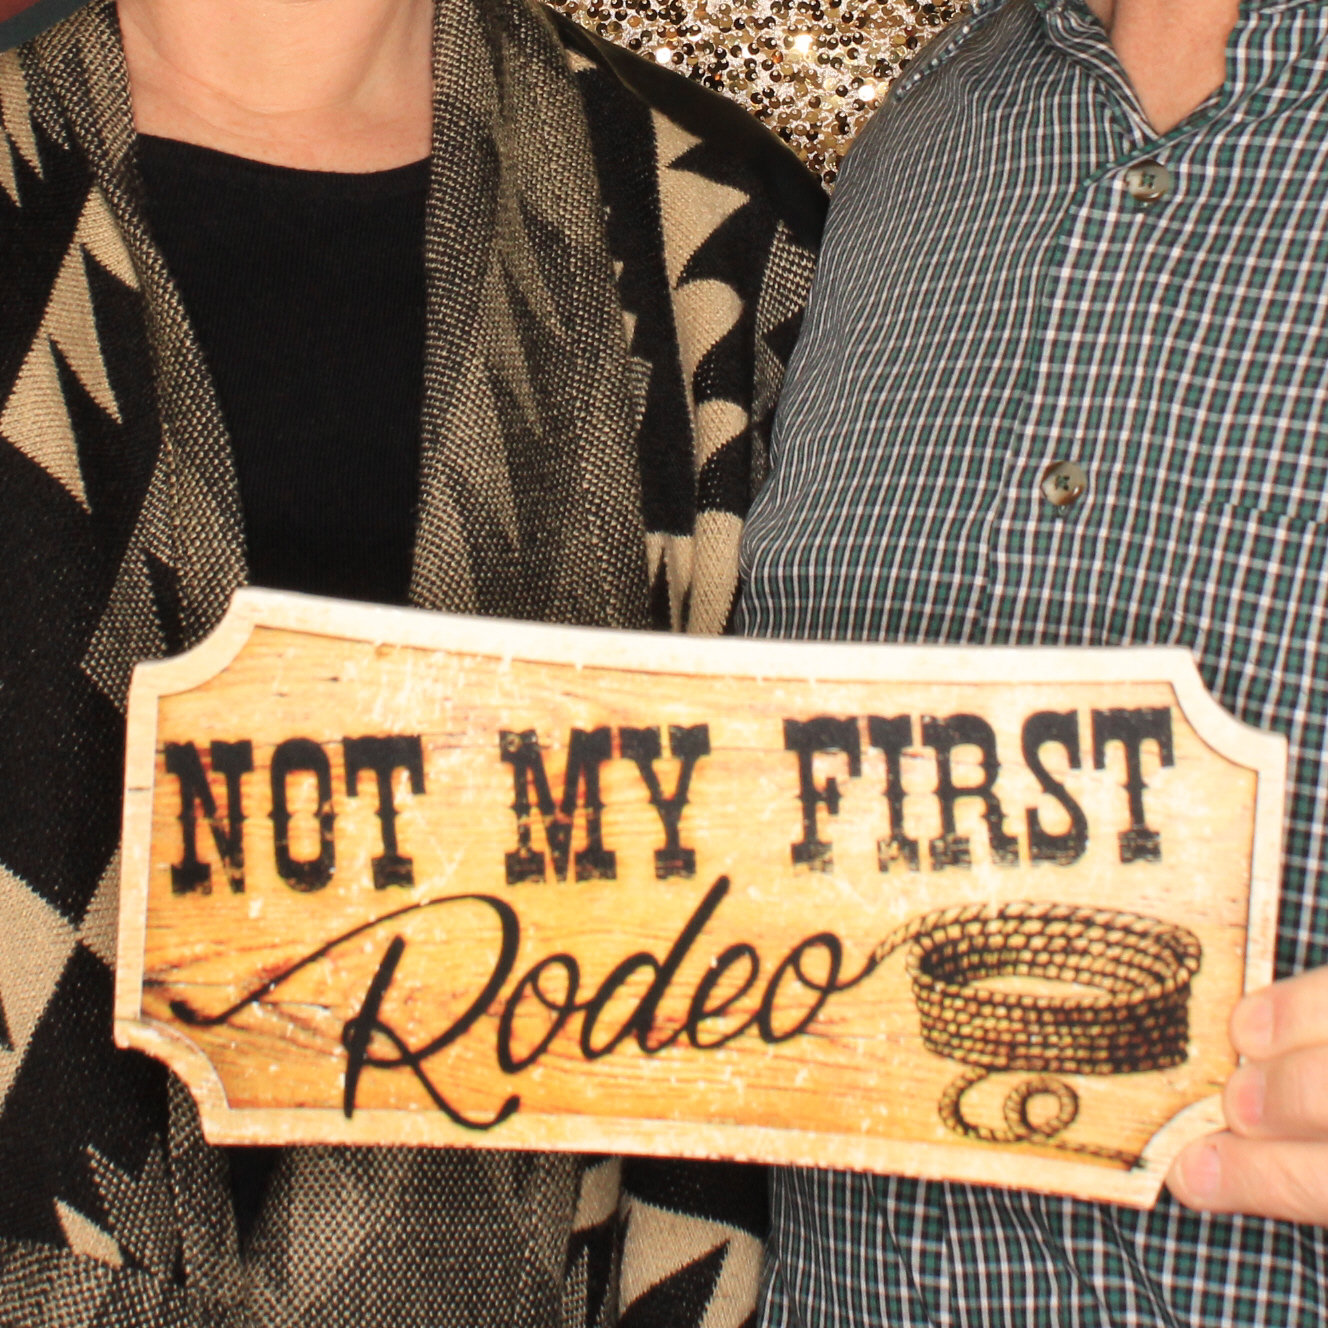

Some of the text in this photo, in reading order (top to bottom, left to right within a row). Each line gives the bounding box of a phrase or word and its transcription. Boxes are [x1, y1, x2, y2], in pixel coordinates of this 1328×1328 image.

[164, 705, 1175, 895] NOT MY FIRST
[170, 875, 876, 1131] Rodeo
